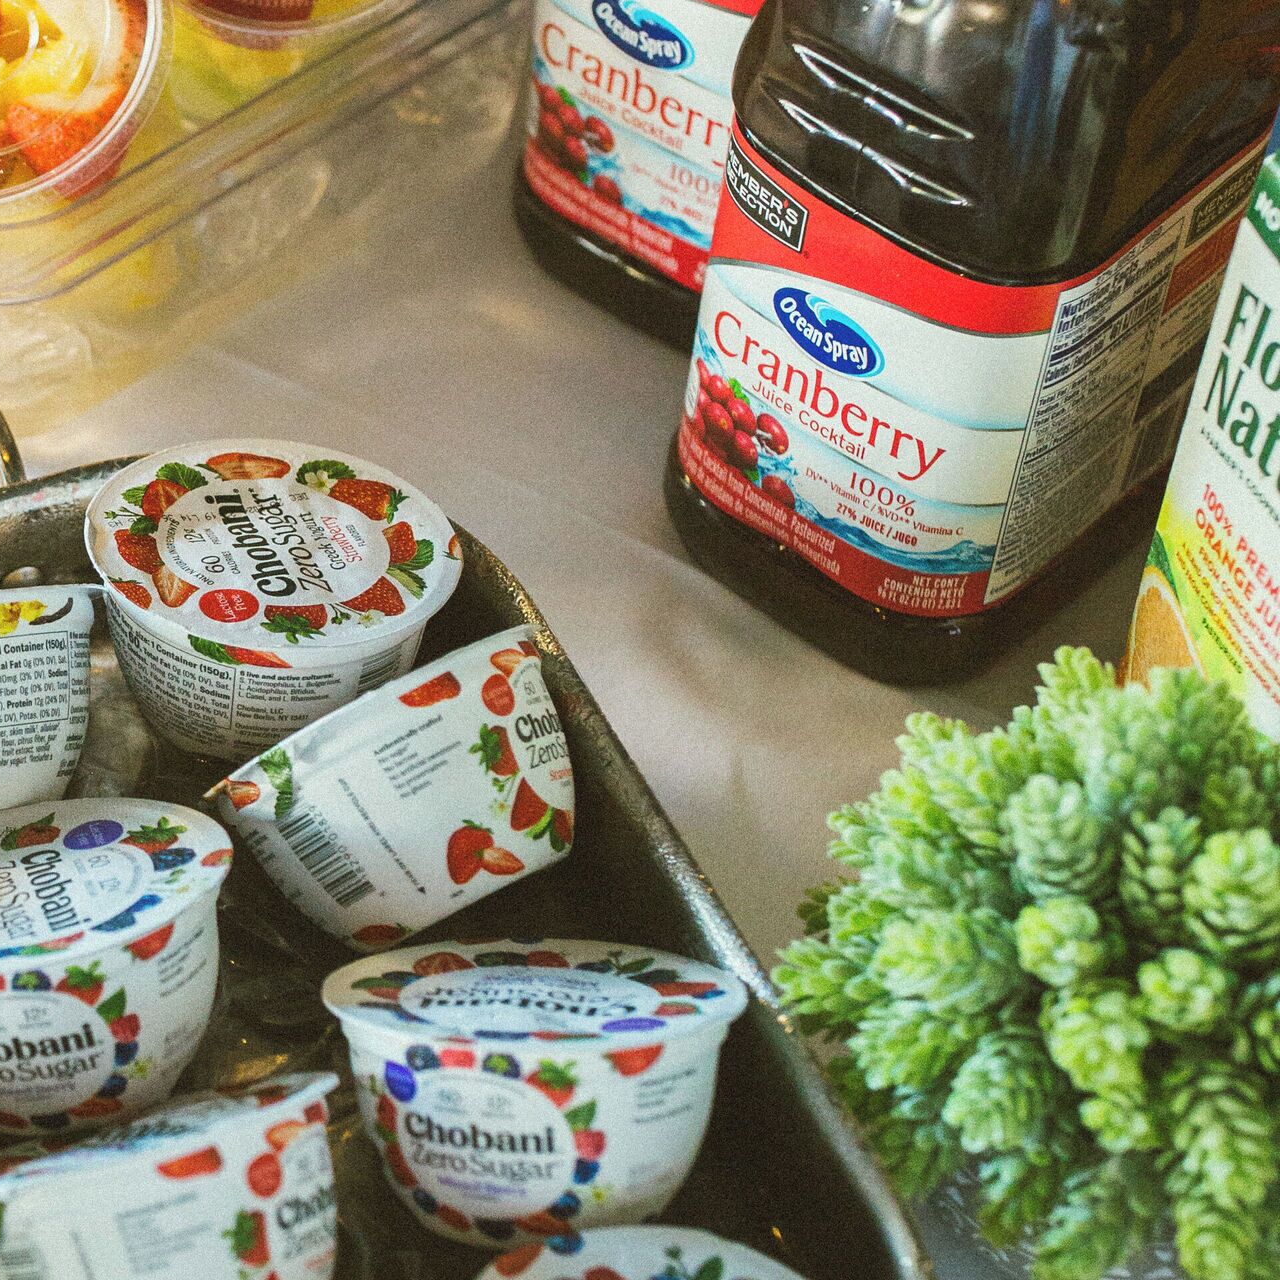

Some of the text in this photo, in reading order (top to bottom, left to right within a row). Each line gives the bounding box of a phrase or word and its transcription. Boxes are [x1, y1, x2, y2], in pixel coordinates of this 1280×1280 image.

[595, 2, 681, 62] Ocean Spray
[780, 297, 868, 370] Ocean Spray
[714, 311, 947, 481] Cranberry
[751, 381, 866, 460] Juice Cocktail
[850, 472, 916, 517] 100%
[321, 515, 363, 563] Strawberry
[836, 502, 918, 547] 27% JUICE JUGO
[204, 494, 297, 597] Chobani
[252, 492, 333, 593] Zero Sugar
[299, 511, 346, 570] Greek Yogurt
[201, 555, 225, 574] 60
[221, 550, 240, 575] CALORIES
[195, 573, 215, 586] ONLY
[214, 592, 237, 621] Lactose
[231, 593, 247, 611] Free
[3, 641, 44, 654] Container
[156, 644, 198, 669] Container
[0, 673, 18, 684] 10mg
[48, 668, 68, 678] Sodium
[10, 660, 22, 669] Fat
[23, 658, 32, 668] 0g
[0, 687, 17, 697] Fiber
[199, 685, 231, 701] Sodium
[215, 680, 231, 691] Sat.
[6, 699, 32, 710] Protein
[211, 698, 230, 710] Total
[20, 848, 93, 932] Chobani
[17, 1049, 103, 1084] Sugar
[403, 1111, 555, 1154] Chobani
